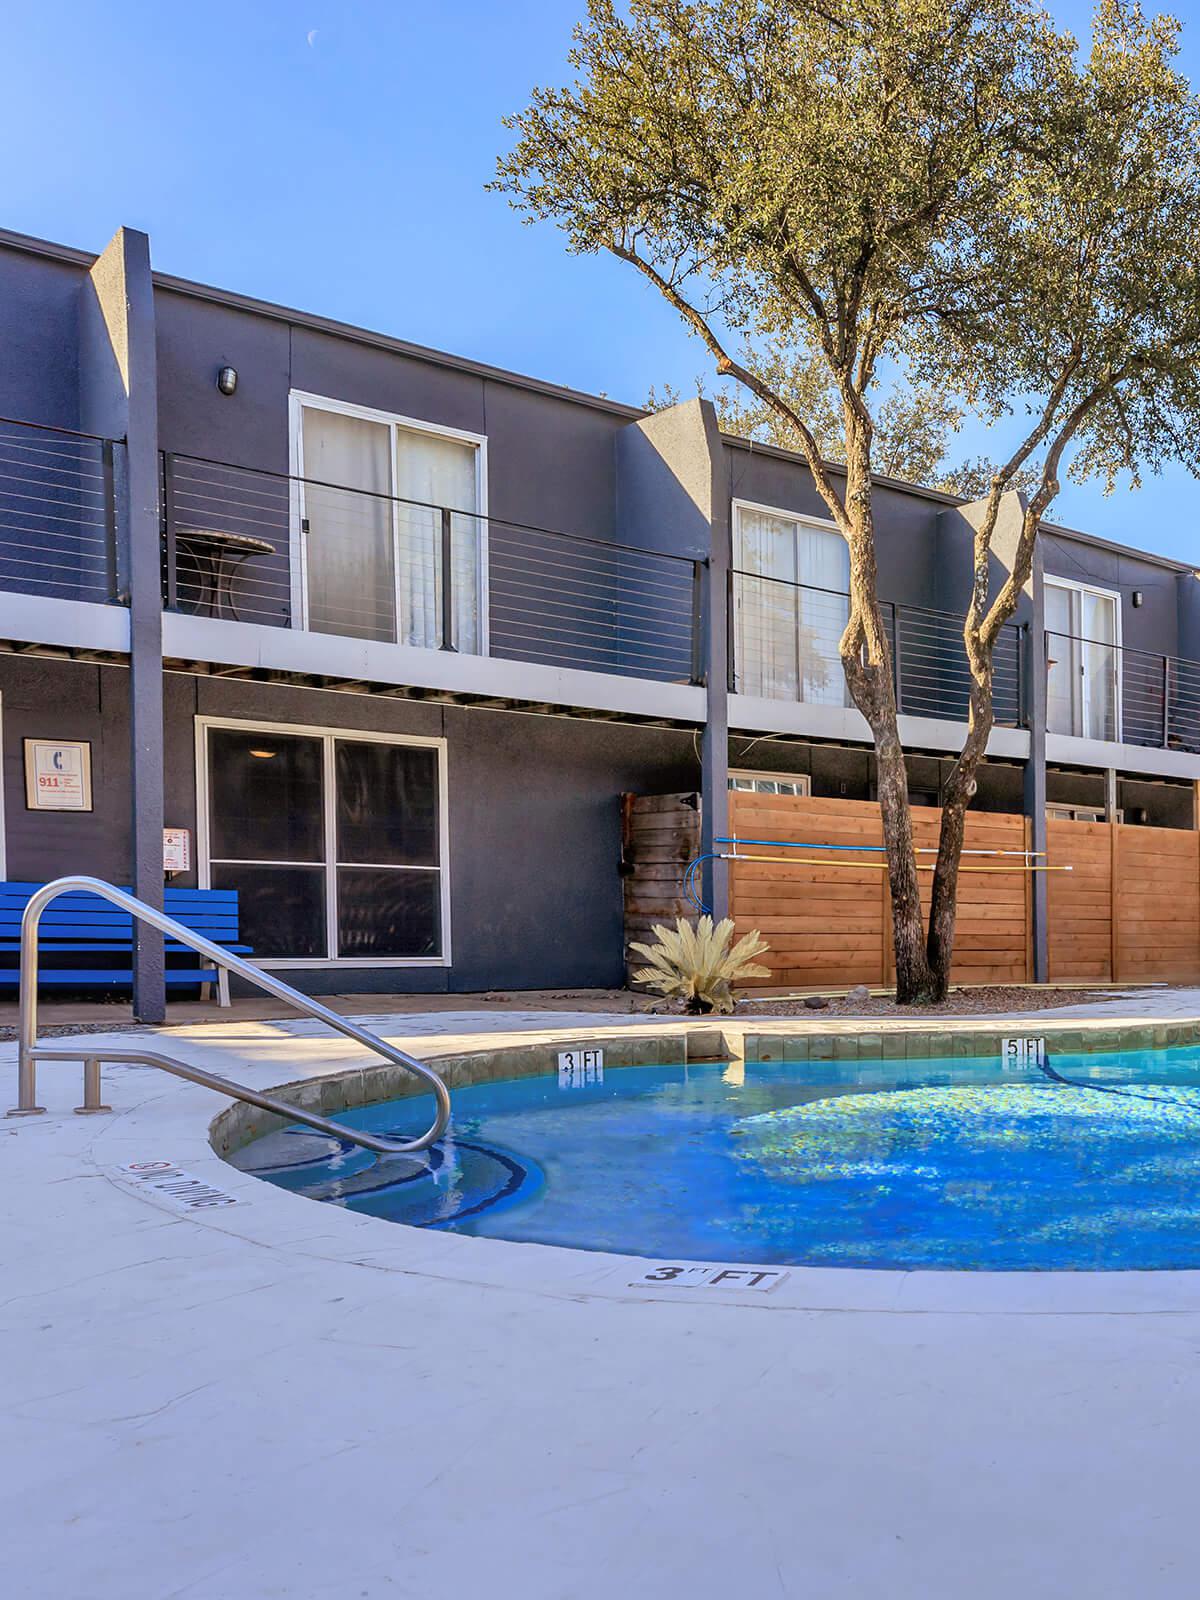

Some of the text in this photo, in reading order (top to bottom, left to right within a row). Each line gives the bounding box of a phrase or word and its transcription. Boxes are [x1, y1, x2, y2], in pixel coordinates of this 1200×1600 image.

[39, 777, 59, 787] 911
[1007, 1038, 1041, 1057] 5 FT
[564, 1050, 600, 1072] 3 FT
[153, 1180, 237, 1207] DIVING
[644, 1266, 685, 1281] 3
[708, 1269, 779, 1287] FT
